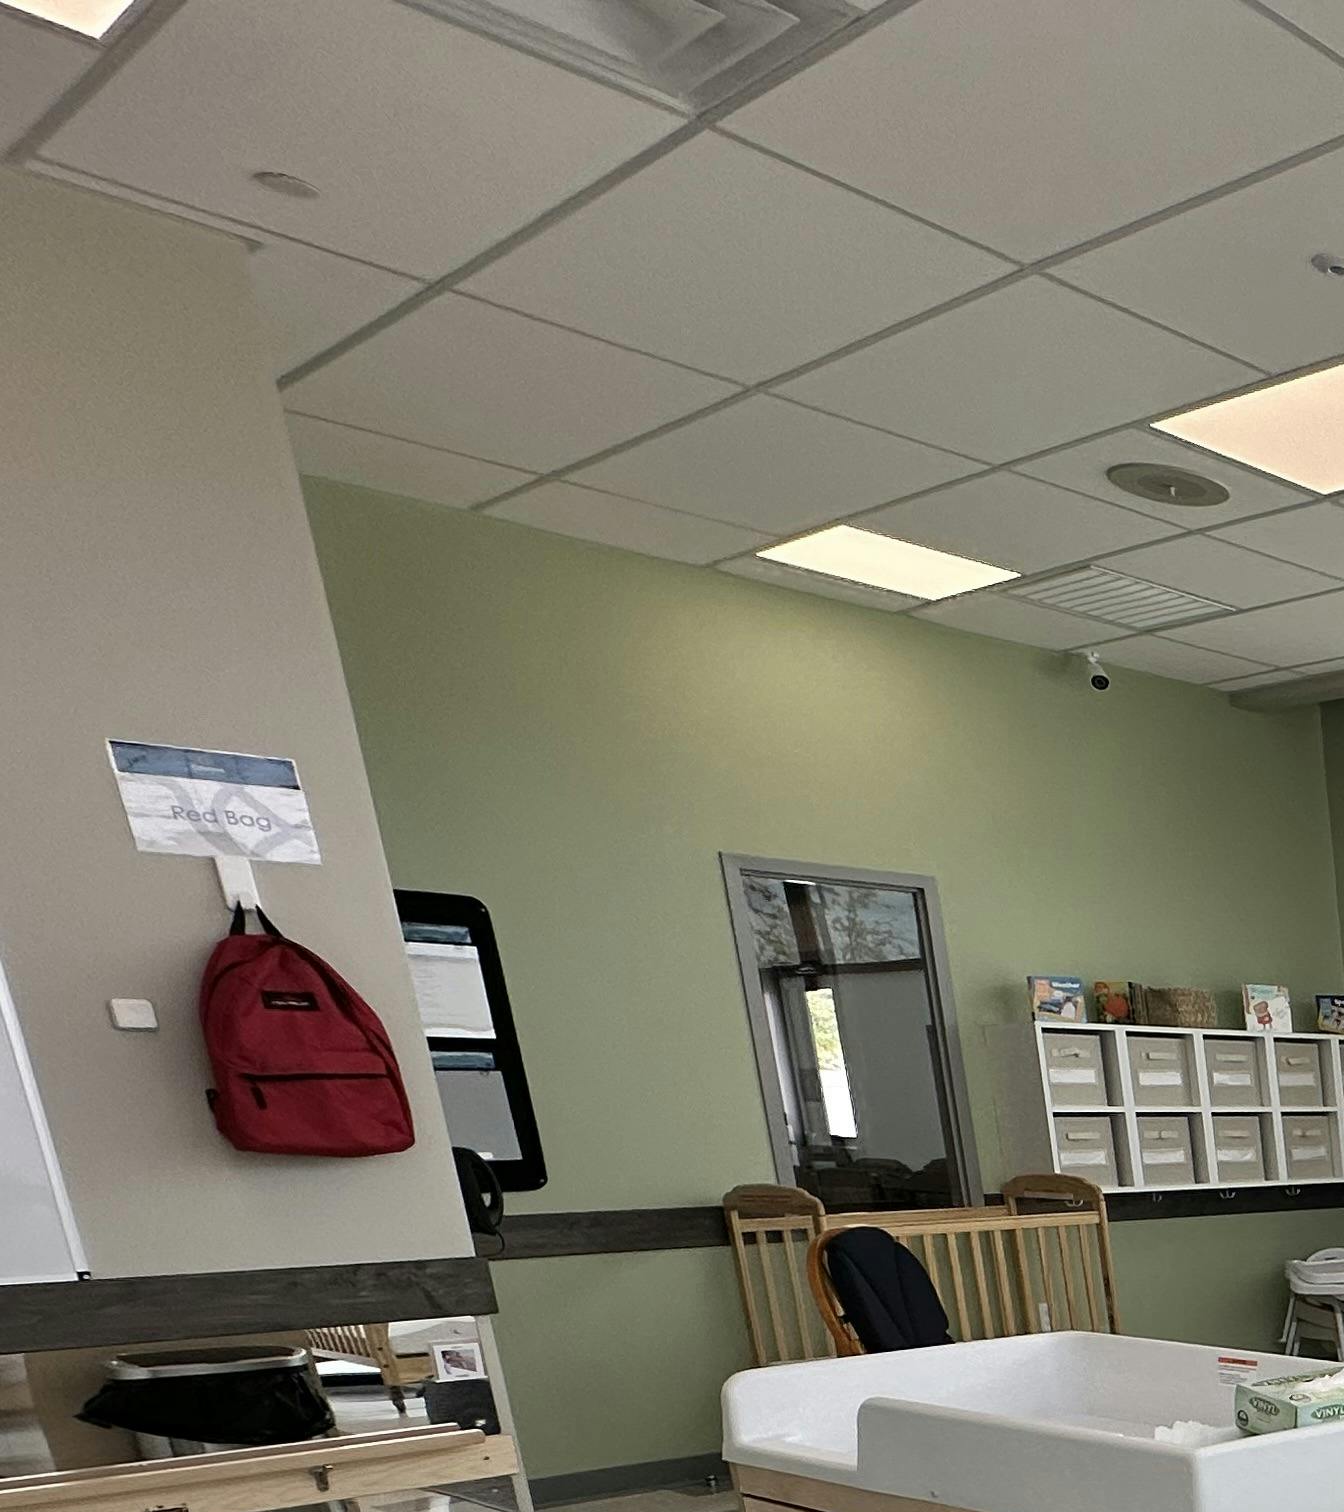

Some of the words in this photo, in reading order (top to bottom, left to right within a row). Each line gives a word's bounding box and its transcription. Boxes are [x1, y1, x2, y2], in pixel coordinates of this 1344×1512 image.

[170, 805, 219, 825] Red
[225, 810, 272, 832] Bag
[1252, 1398, 1278, 1414] VINYL
